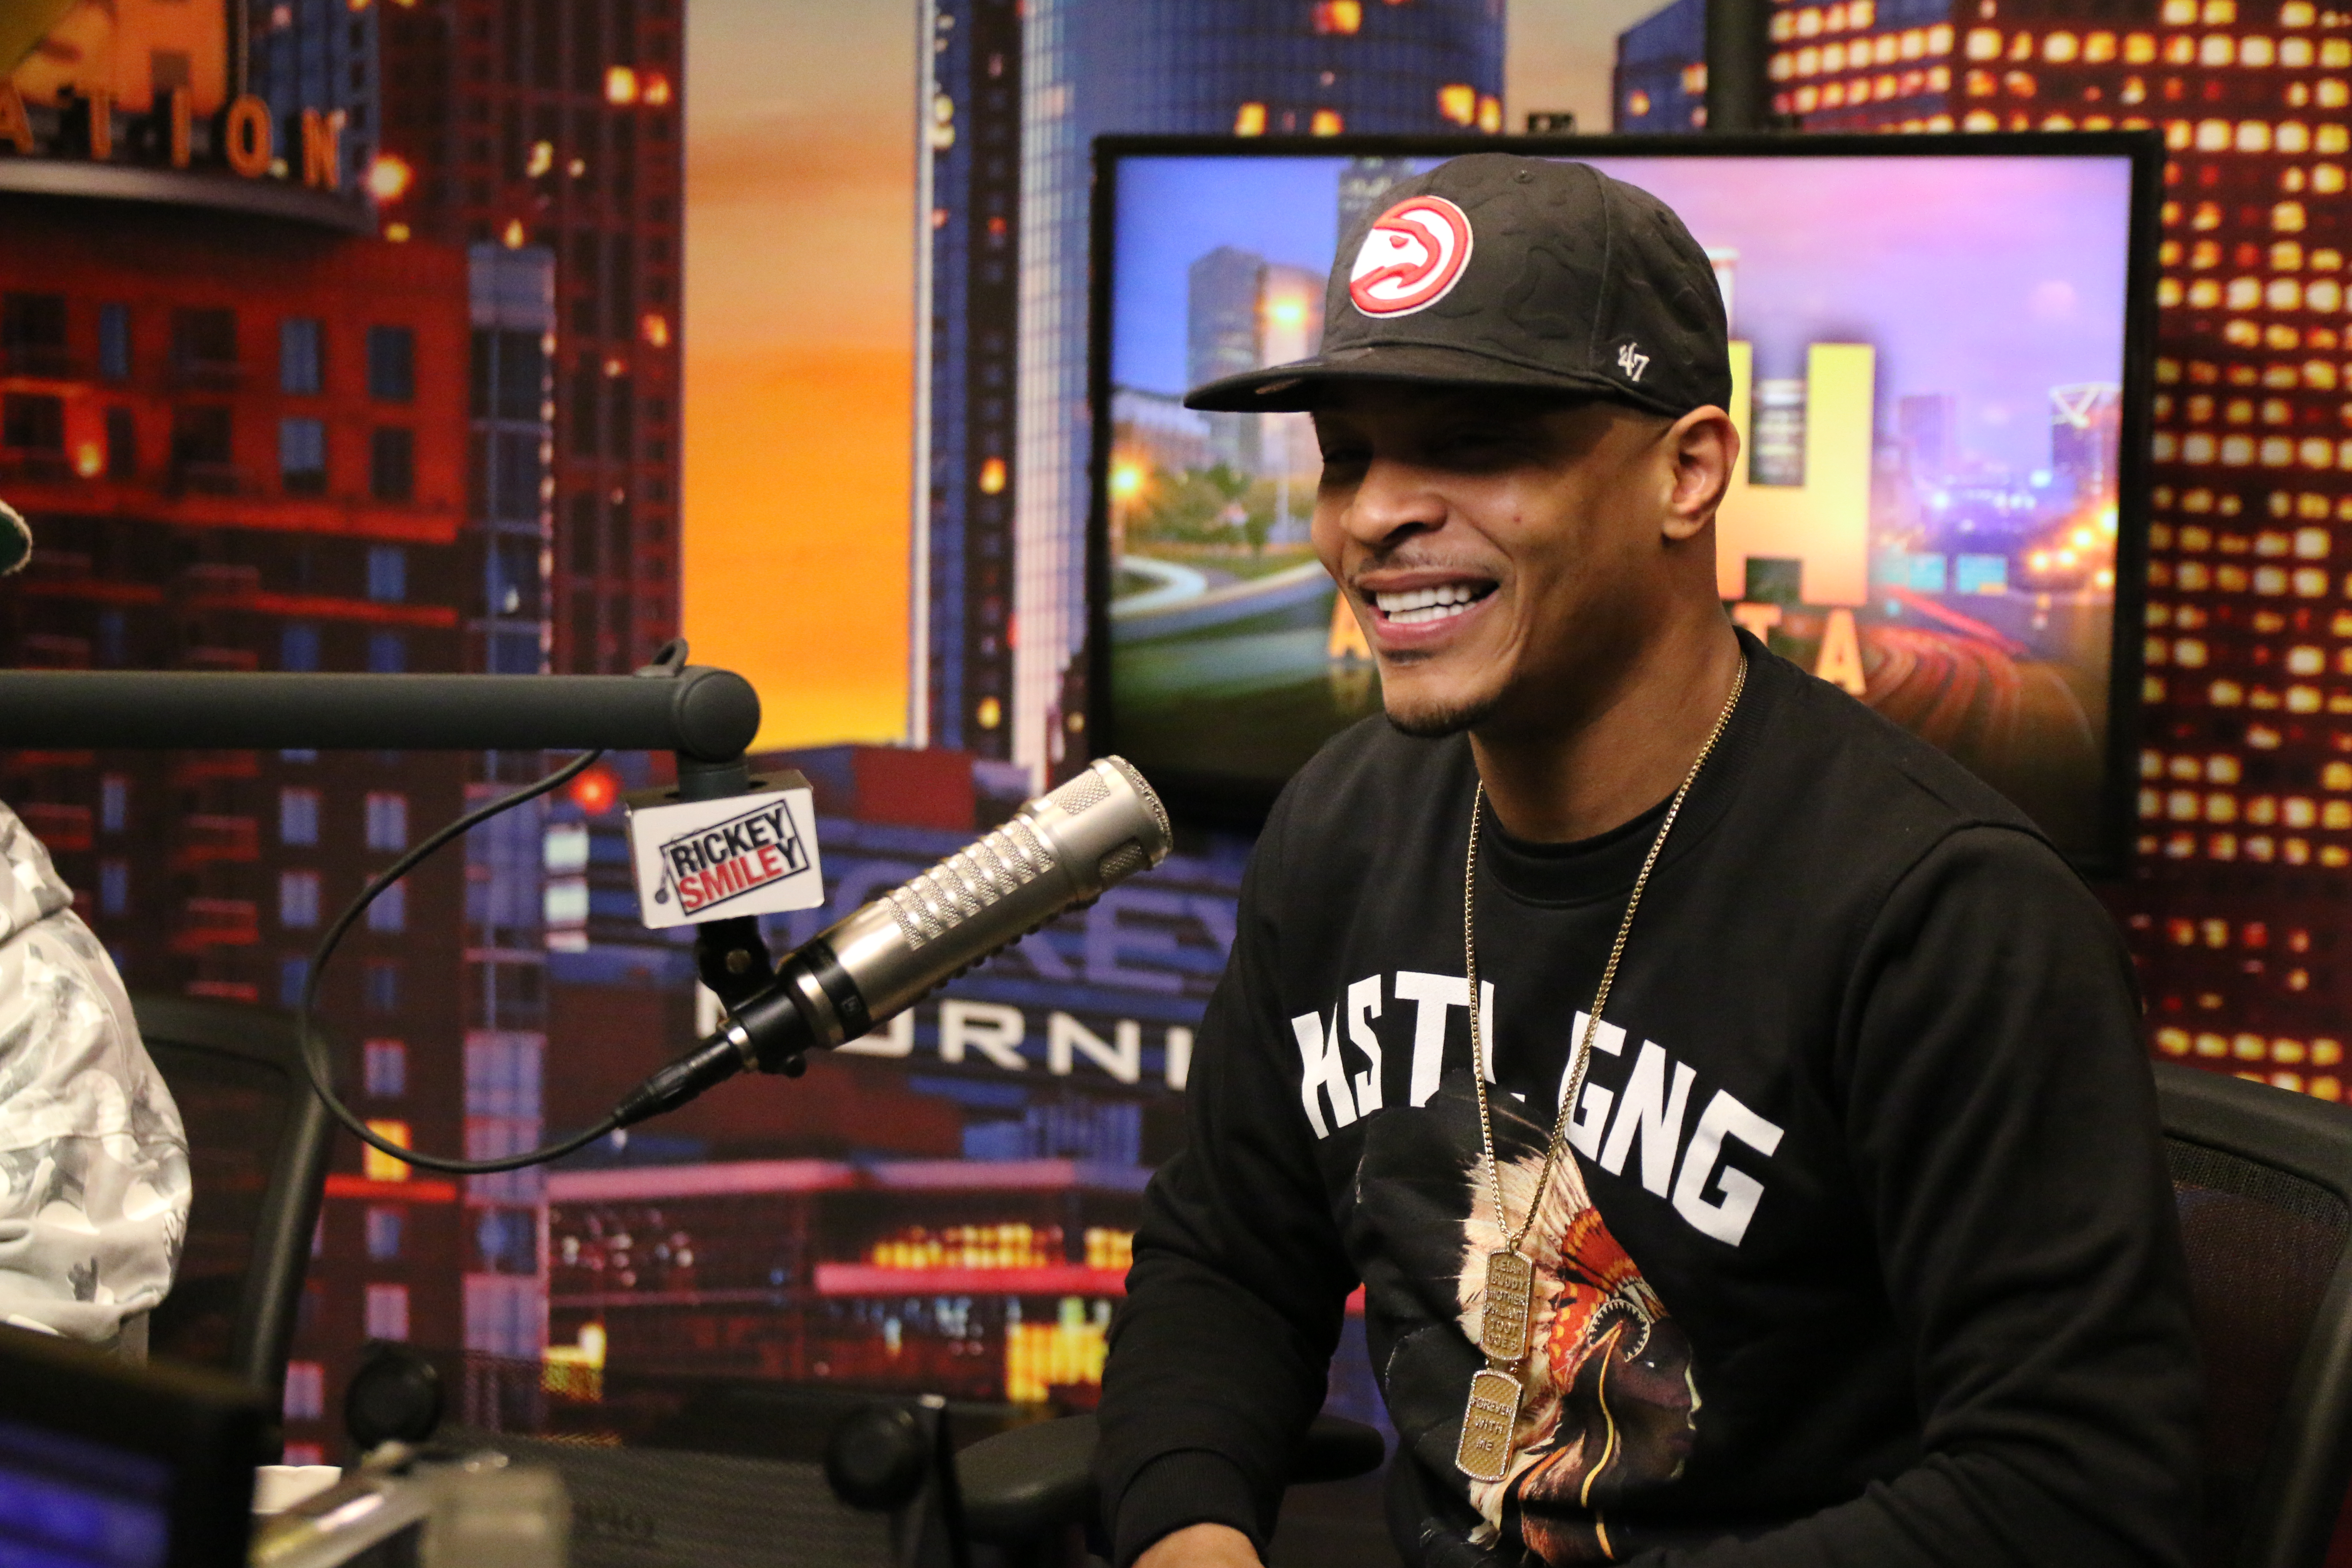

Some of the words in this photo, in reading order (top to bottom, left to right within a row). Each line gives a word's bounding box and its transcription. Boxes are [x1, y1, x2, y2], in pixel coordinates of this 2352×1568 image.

[670, 808, 784, 877] RICKEY
[679, 836, 799, 908] SMILEY
[1558, 1010, 1784, 1247] GNG
[1487, 1291, 1525, 1306] MOTHER
[1470, 1396, 1513, 1417] FOREVER
[1474, 1415, 1503, 1435] WITH
